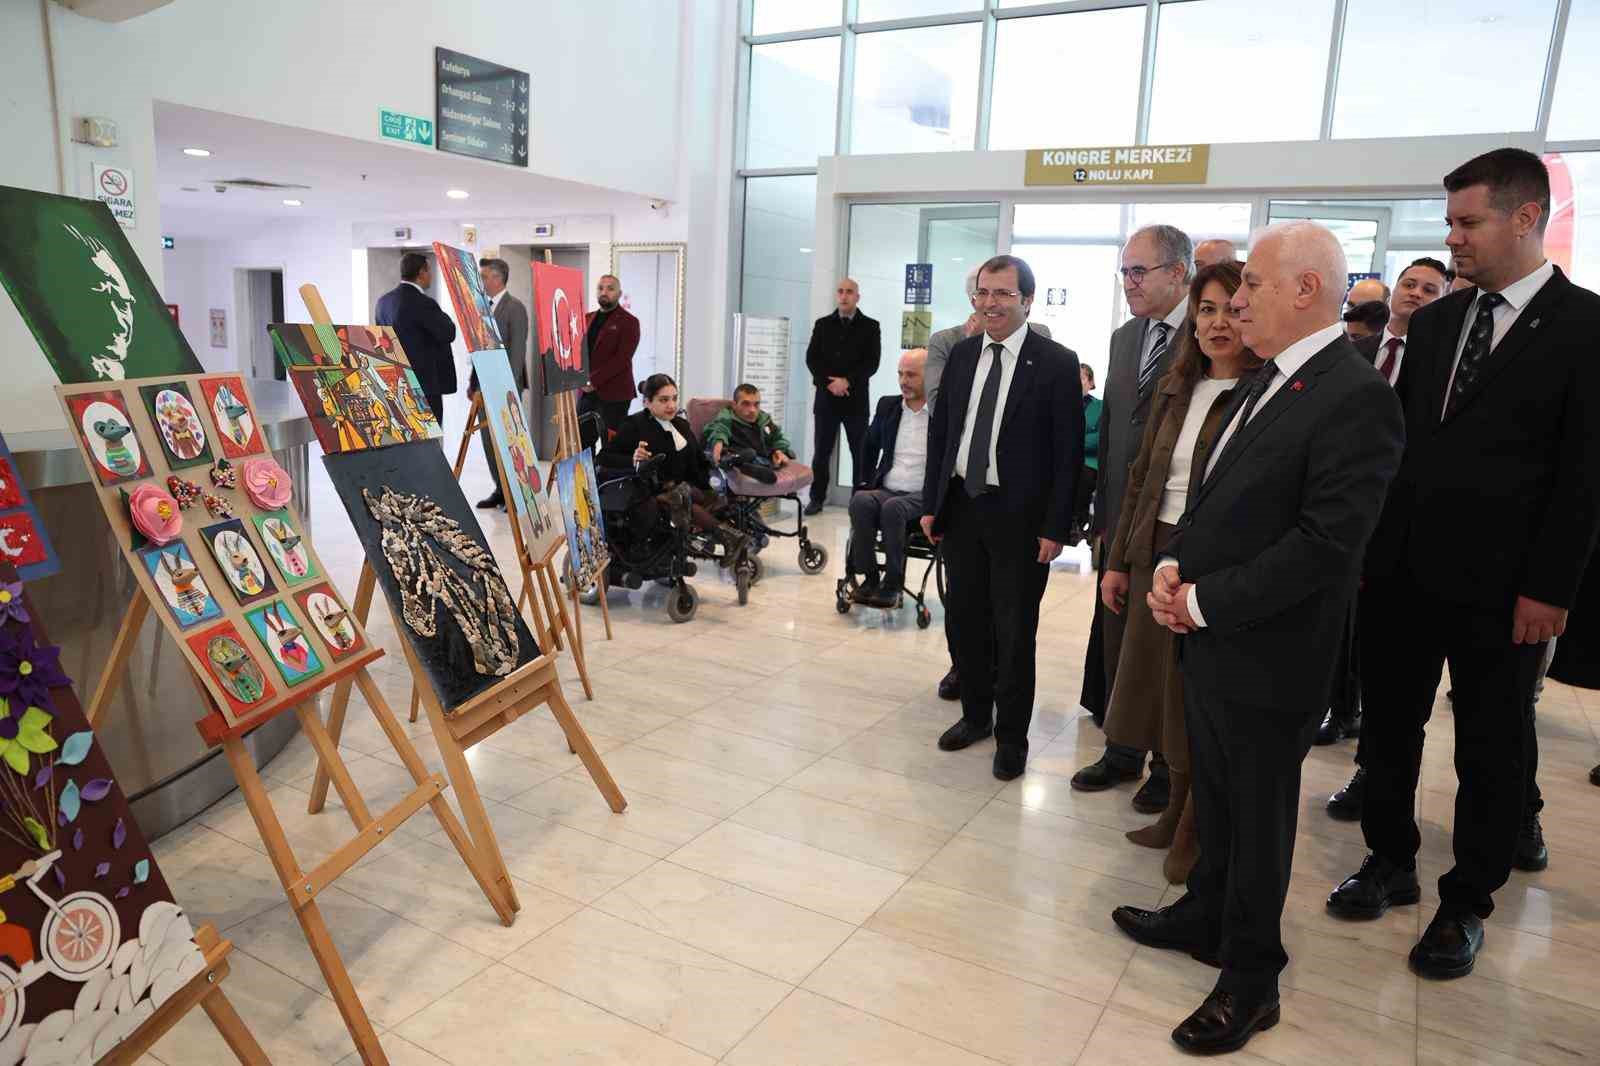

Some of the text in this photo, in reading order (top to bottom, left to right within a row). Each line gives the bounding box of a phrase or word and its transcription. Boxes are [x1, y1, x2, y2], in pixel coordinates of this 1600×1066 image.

[386, 128, 401, 138] EXIT
[1042, 151, 1112, 166] KONGRE
[1074, 168, 1154, 181] 12 NOLU KAPI
